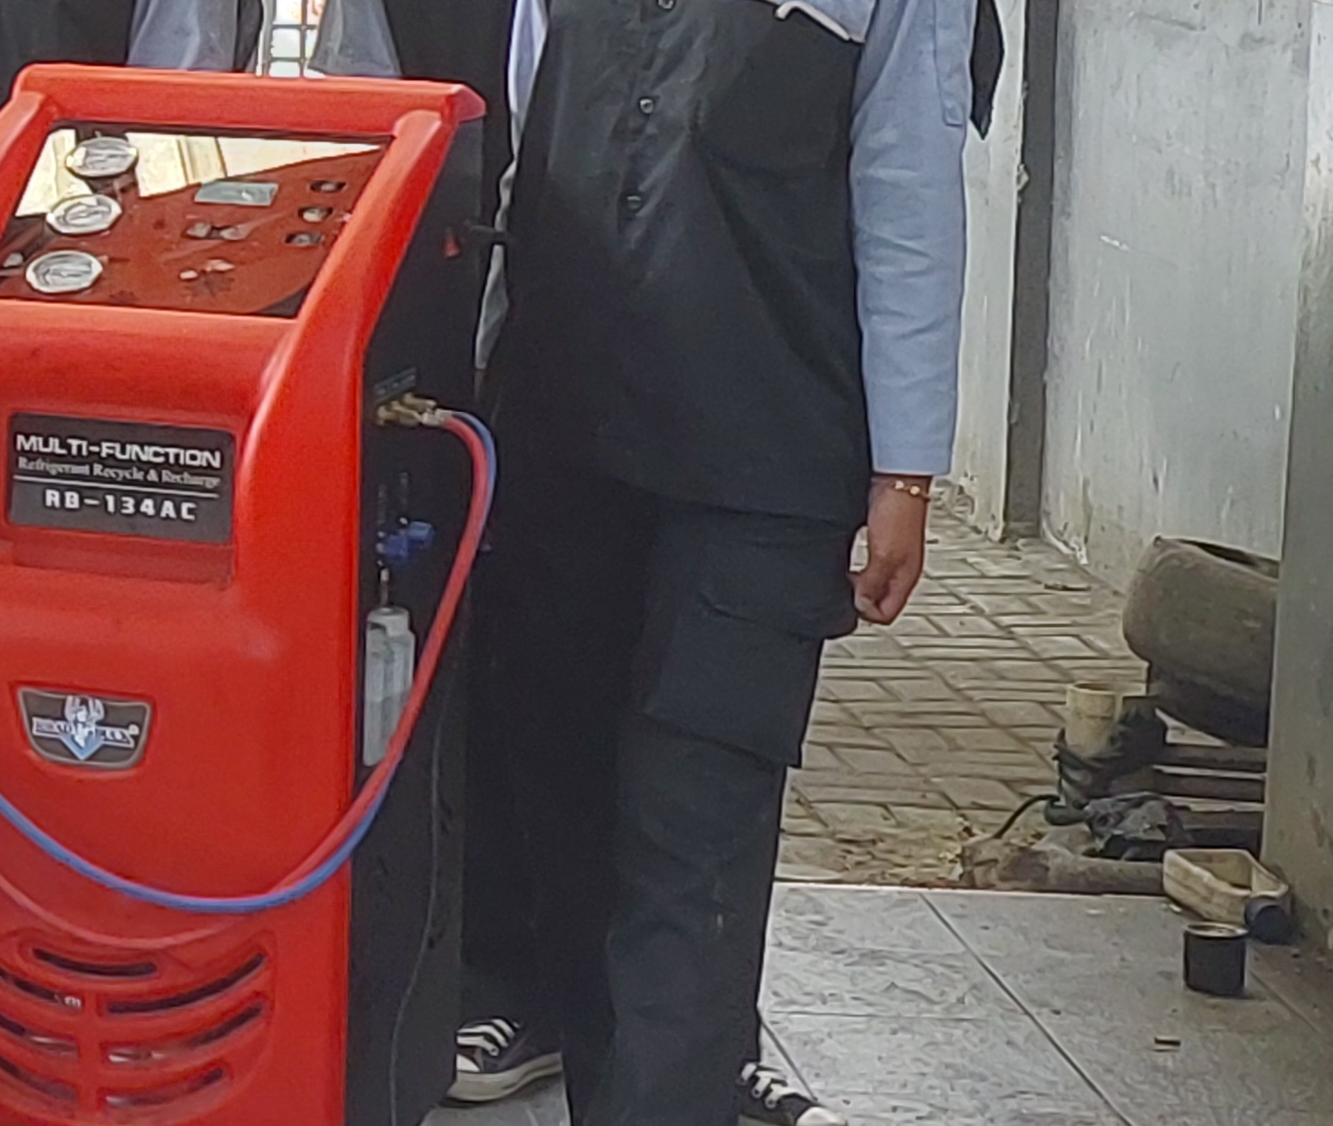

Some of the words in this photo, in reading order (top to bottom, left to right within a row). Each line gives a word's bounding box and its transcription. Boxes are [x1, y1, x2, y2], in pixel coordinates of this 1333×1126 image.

[15, 434, 222, 469] MULTI-FUNCTION
[18, 456, 91, 476] Refrigerant
[93, 462, 144, 481] Recycle
[146, 468, 159, 482] &
[162, 469, 222, 489] Recharge
